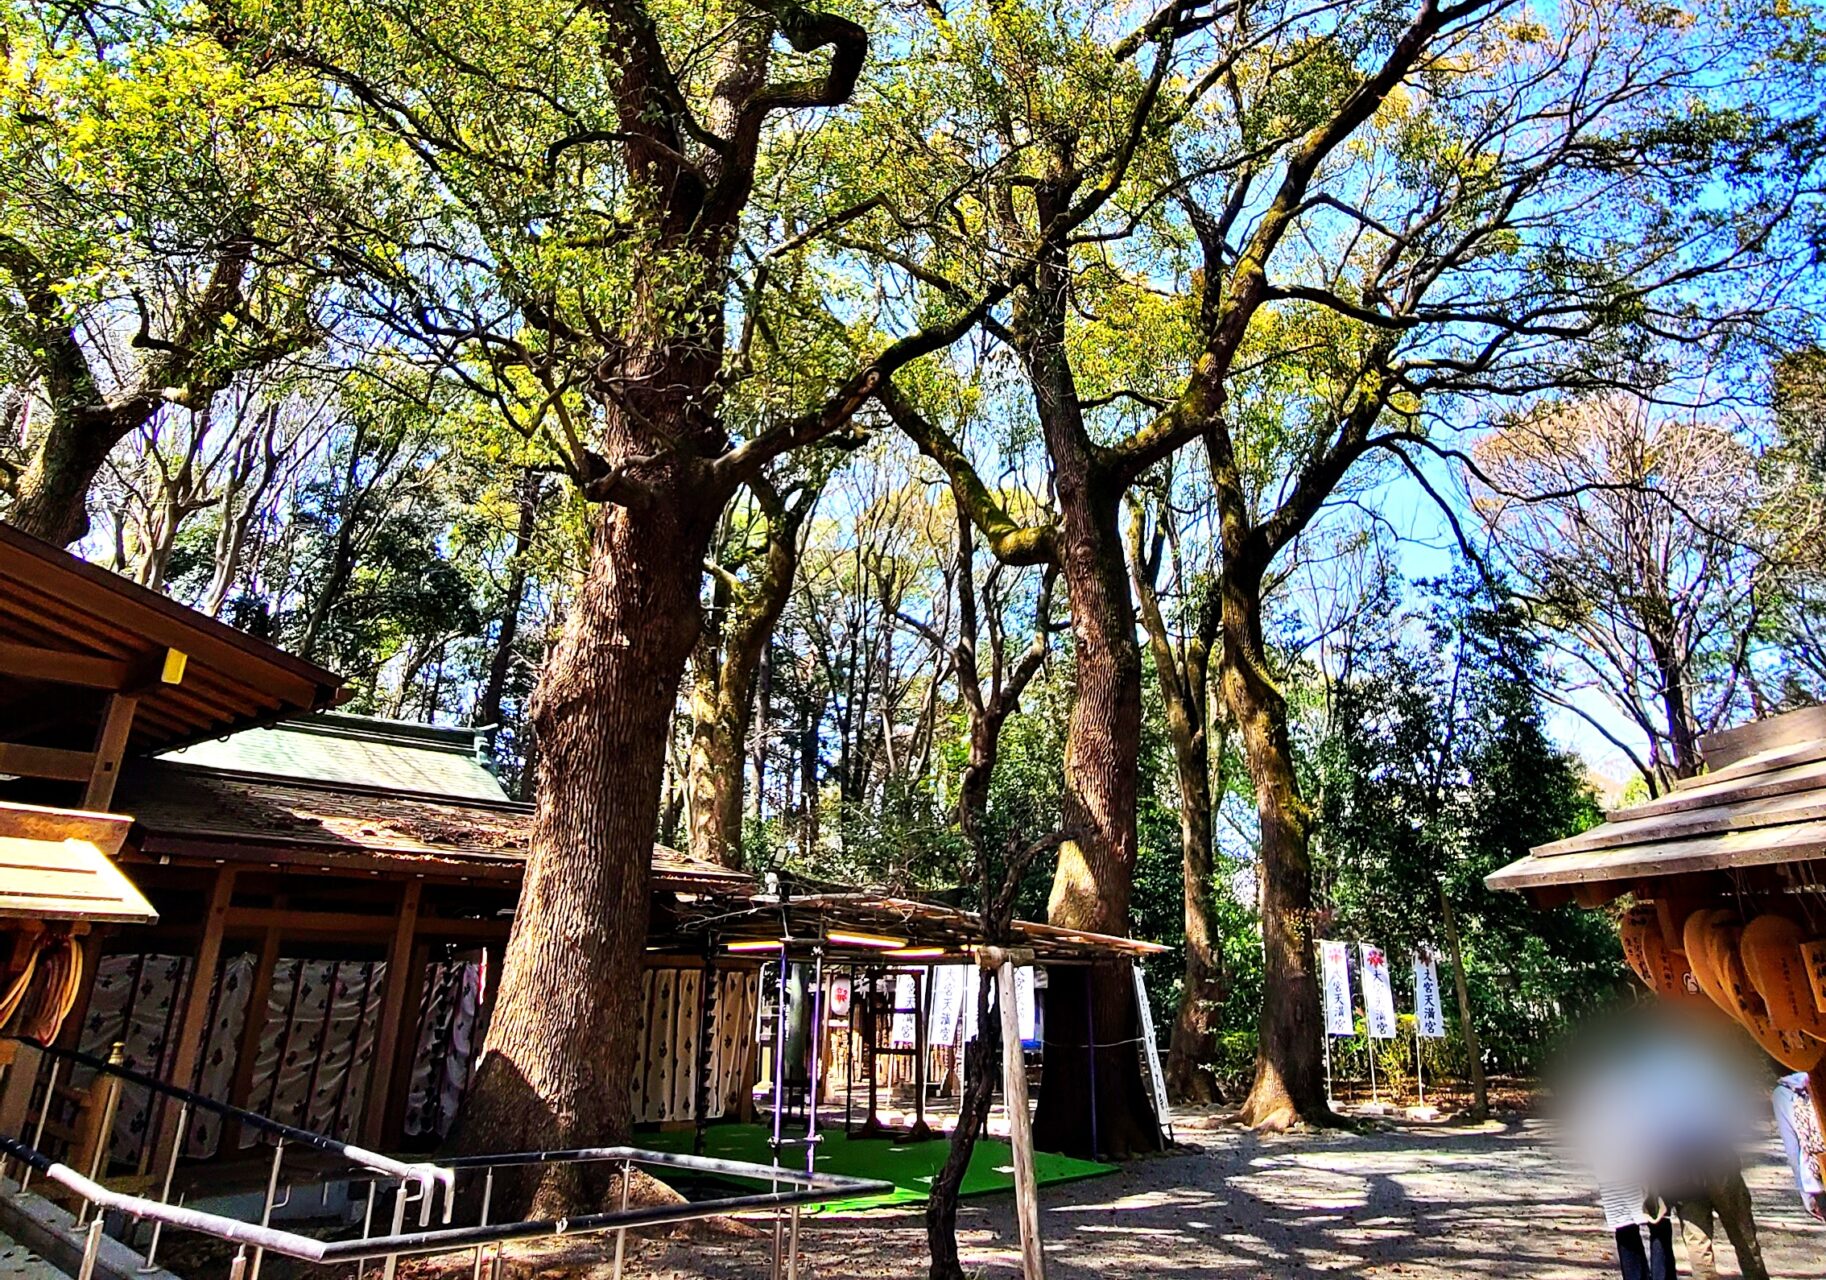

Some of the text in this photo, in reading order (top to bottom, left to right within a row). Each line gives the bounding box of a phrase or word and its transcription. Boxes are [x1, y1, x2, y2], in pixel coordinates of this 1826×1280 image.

[939, 969, 955, 1042] 大宮天満宮
[1331, 969, 1346, 1031] 大宮天満宮
[1423, 969, 1437, 1034] 大宮天満宮
